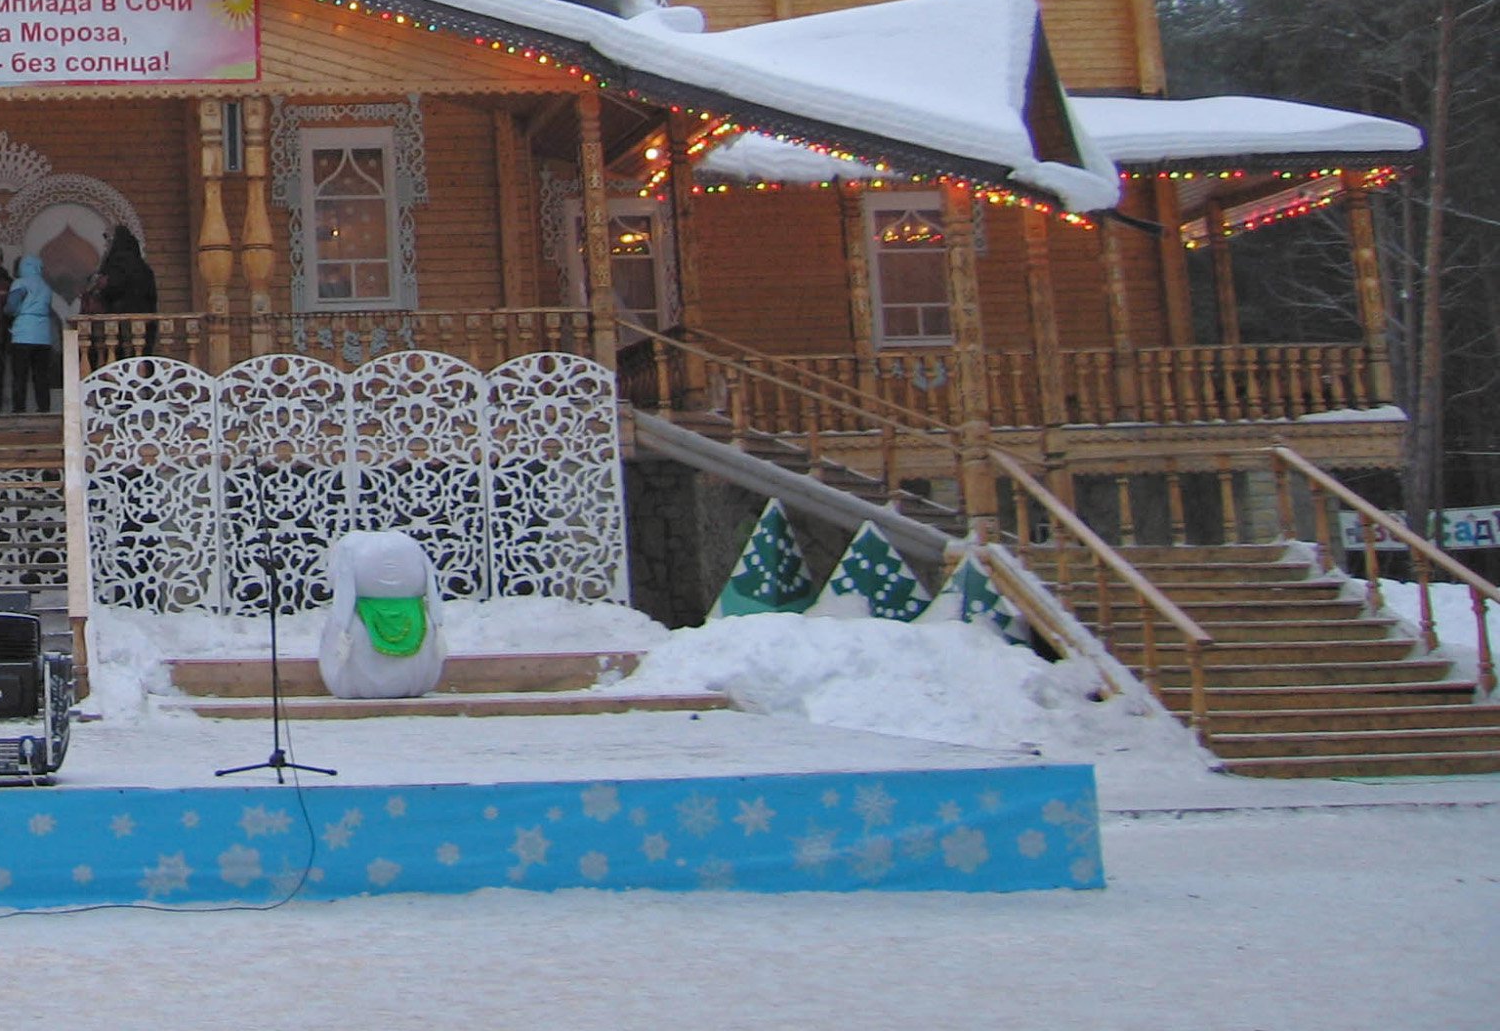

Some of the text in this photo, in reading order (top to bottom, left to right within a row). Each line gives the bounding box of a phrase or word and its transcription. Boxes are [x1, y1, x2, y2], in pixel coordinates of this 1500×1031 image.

[21, 22, 128, 46] Мороза,
[11, 52, 56, 73] без
[65, 50, 170, 75] солнца!
